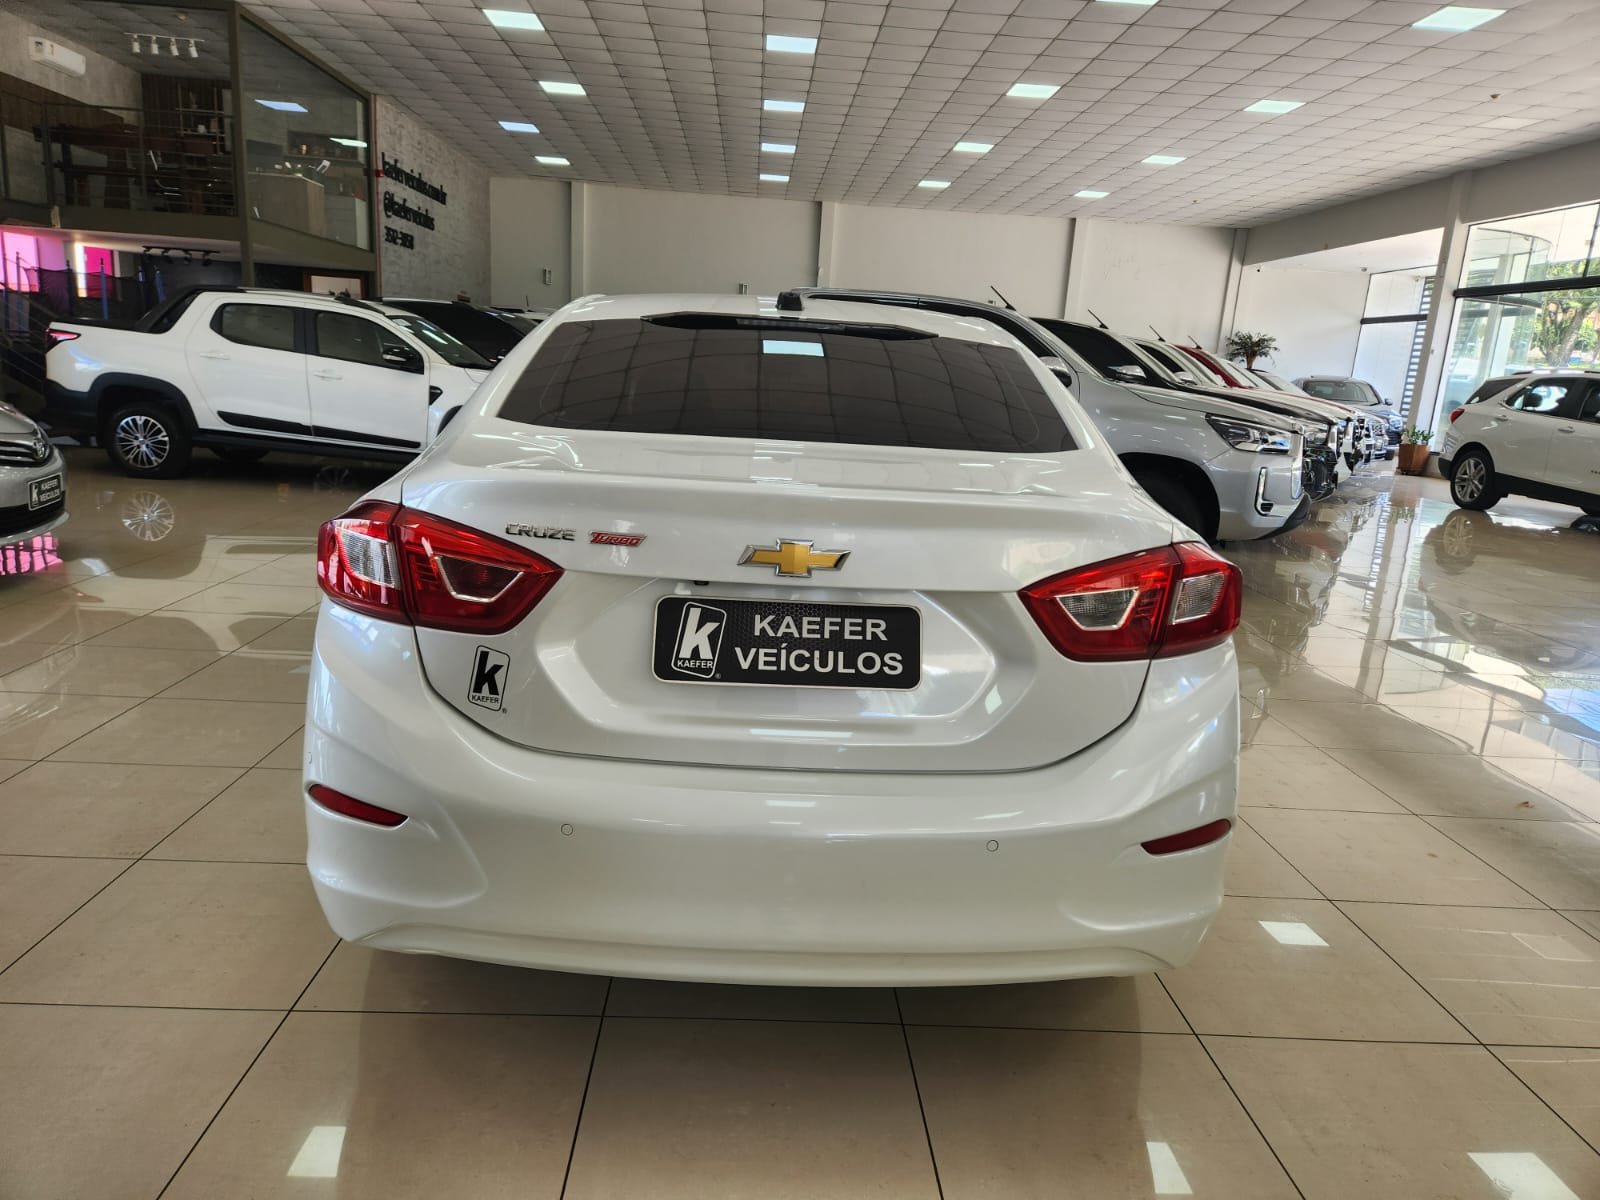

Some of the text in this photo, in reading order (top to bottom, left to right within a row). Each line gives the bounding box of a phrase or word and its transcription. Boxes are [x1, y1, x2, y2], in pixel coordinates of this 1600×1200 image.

[505, 522, 646, 547] CRUZE TURBO
[753, 614, 888, 641] KAEFER
[677, 659, 713, 669] KAEFER
[734, 642, 903, 675] VEÍCULOS
[471, 694, 500, 704] KAEFER
